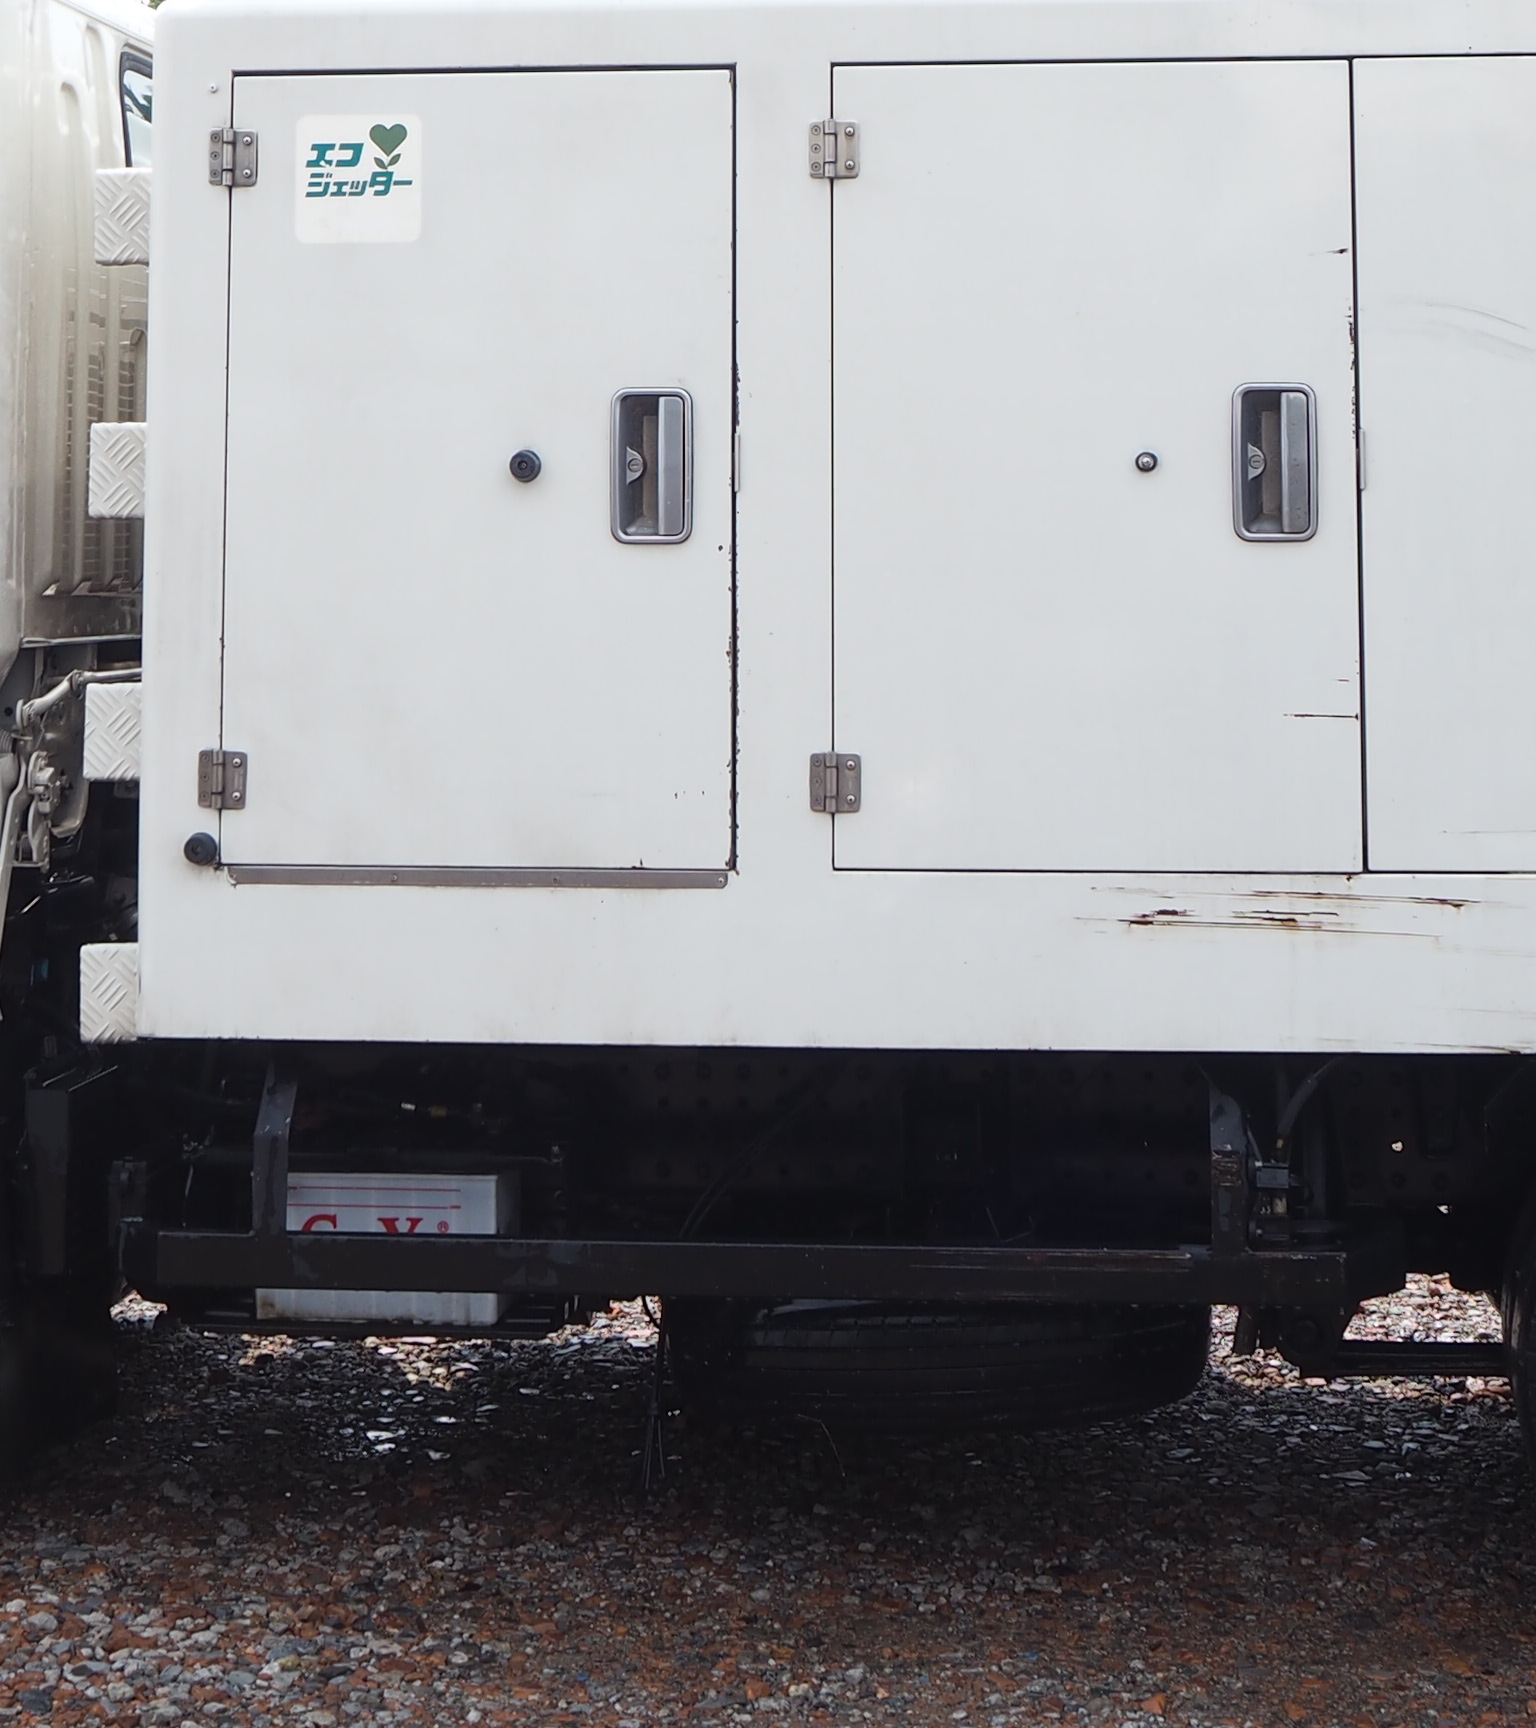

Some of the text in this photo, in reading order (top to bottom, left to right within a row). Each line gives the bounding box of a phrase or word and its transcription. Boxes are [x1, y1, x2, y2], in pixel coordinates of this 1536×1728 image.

[305, 143, 363, 167] エコ
[305, 171, 412, 197] ジェッター
